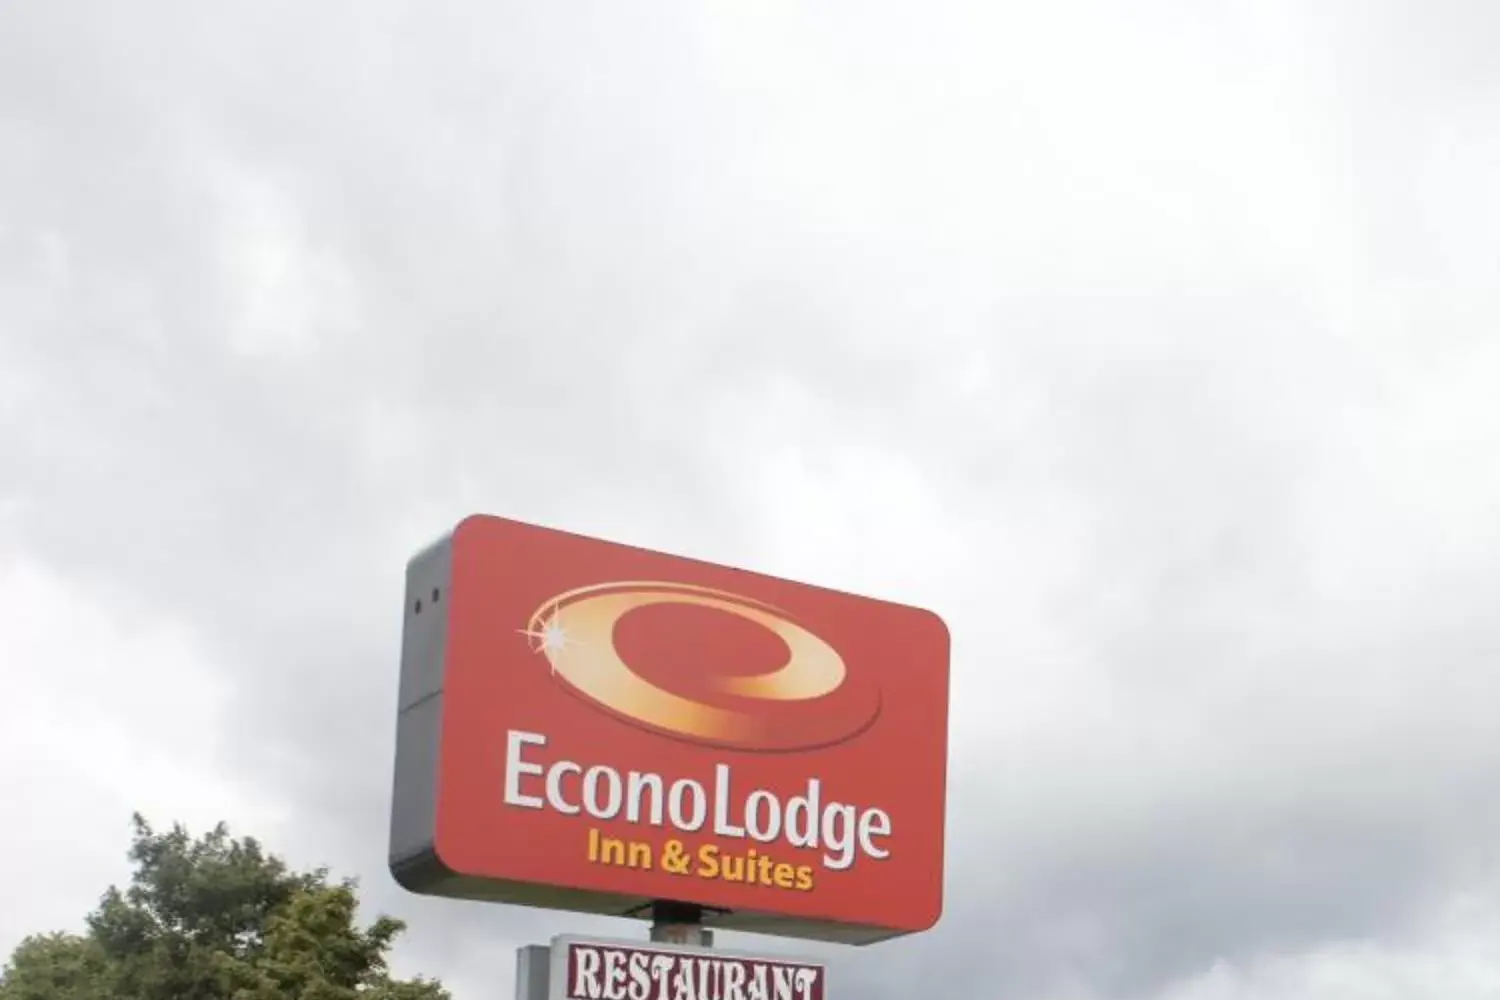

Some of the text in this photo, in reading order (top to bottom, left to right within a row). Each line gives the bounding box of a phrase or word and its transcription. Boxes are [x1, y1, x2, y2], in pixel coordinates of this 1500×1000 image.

[587, 829, 814, 891] Inn & Suites
